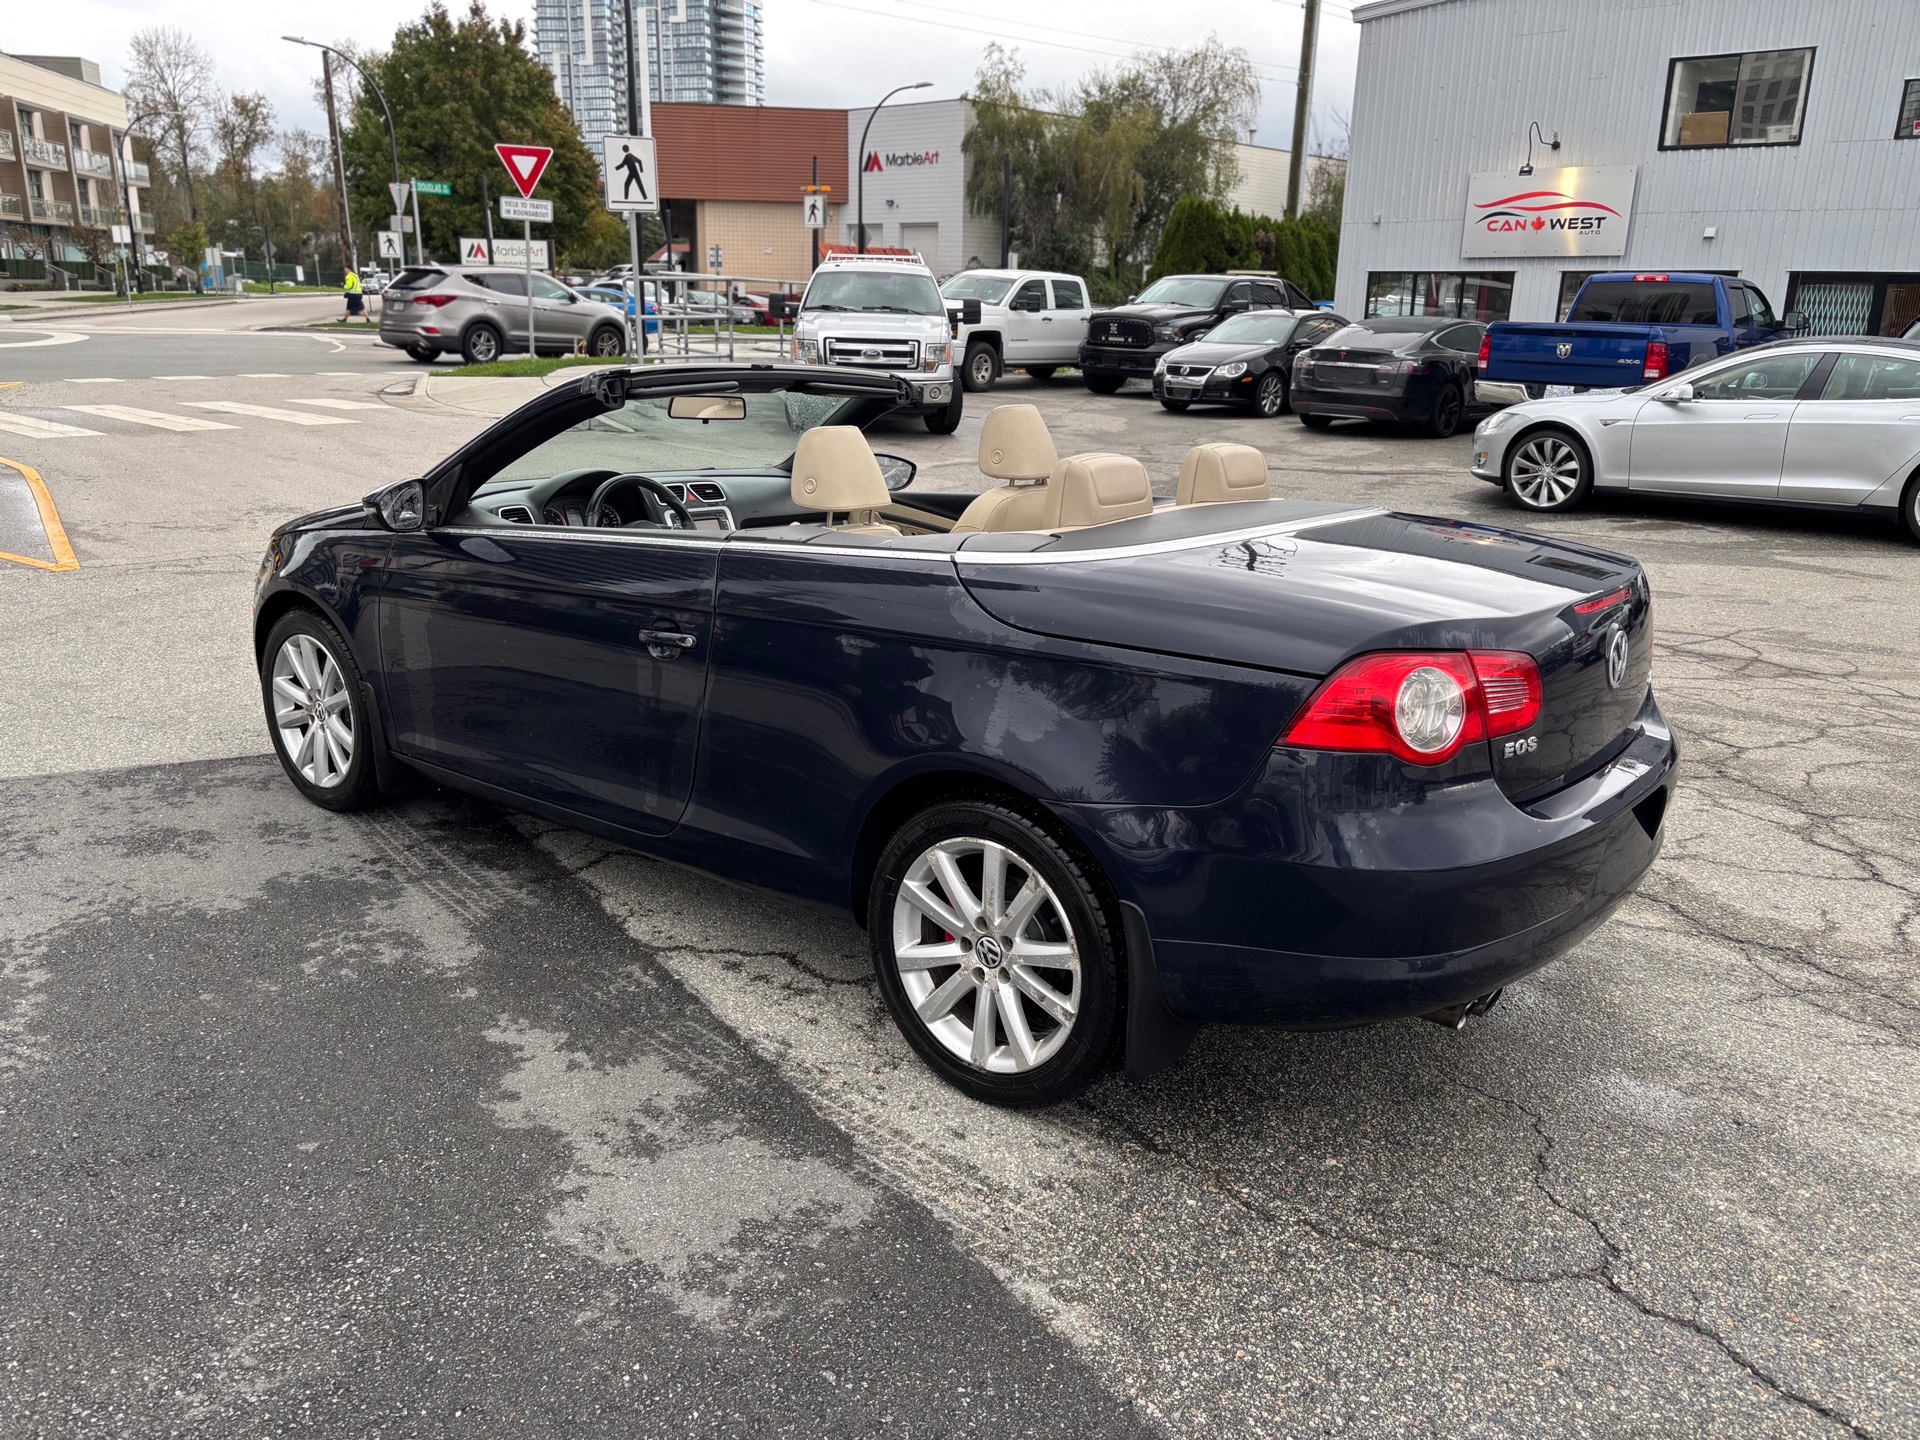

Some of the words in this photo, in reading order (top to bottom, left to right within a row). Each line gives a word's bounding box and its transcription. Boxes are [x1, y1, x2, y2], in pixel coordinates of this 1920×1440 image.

[886, 150, 939, 166] MarbleArt
[417, 182, 441, 194] DOUGLAS
[504, 200, 519, 208] YIELD
[529, 202, 549, 211] TRAFFIC
[513, 209, 549, 219] ROUNDABOUT
[1486, 219, 1527, 232] CAN
[1549, 216, 1607, 230] WEST
[1504, 736, 1538, 759] EOS
